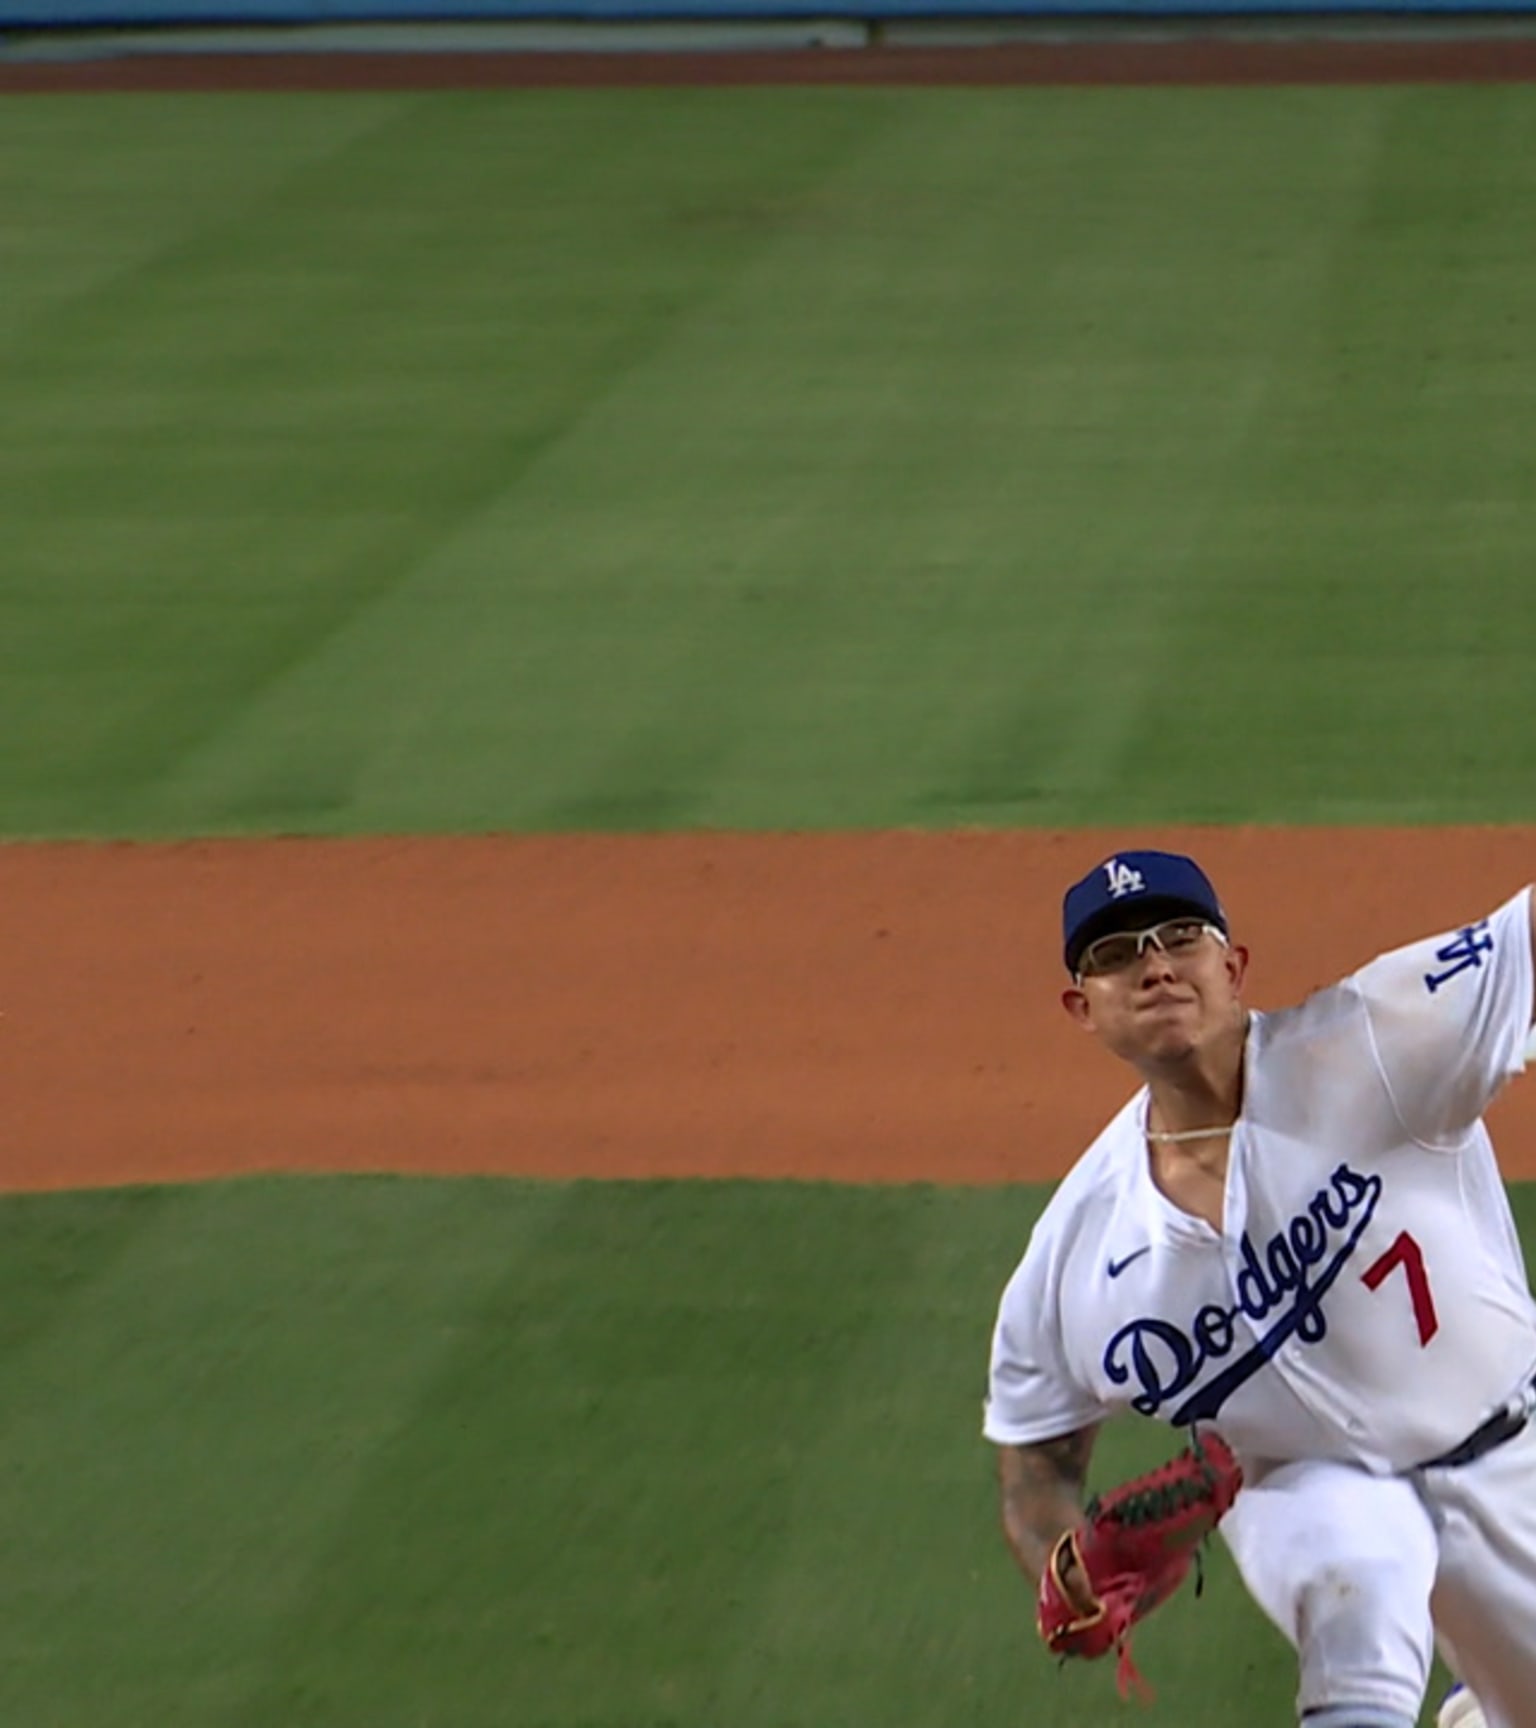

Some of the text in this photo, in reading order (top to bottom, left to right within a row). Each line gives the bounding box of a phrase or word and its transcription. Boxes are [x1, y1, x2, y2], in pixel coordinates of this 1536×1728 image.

[1103, 858, 1146, 898] LA
[1424, 919, 1494, 994] LA
[1104, 1164, 1381, 1418] Dodgers
[1360, 1230, 1439, 1349] 7
